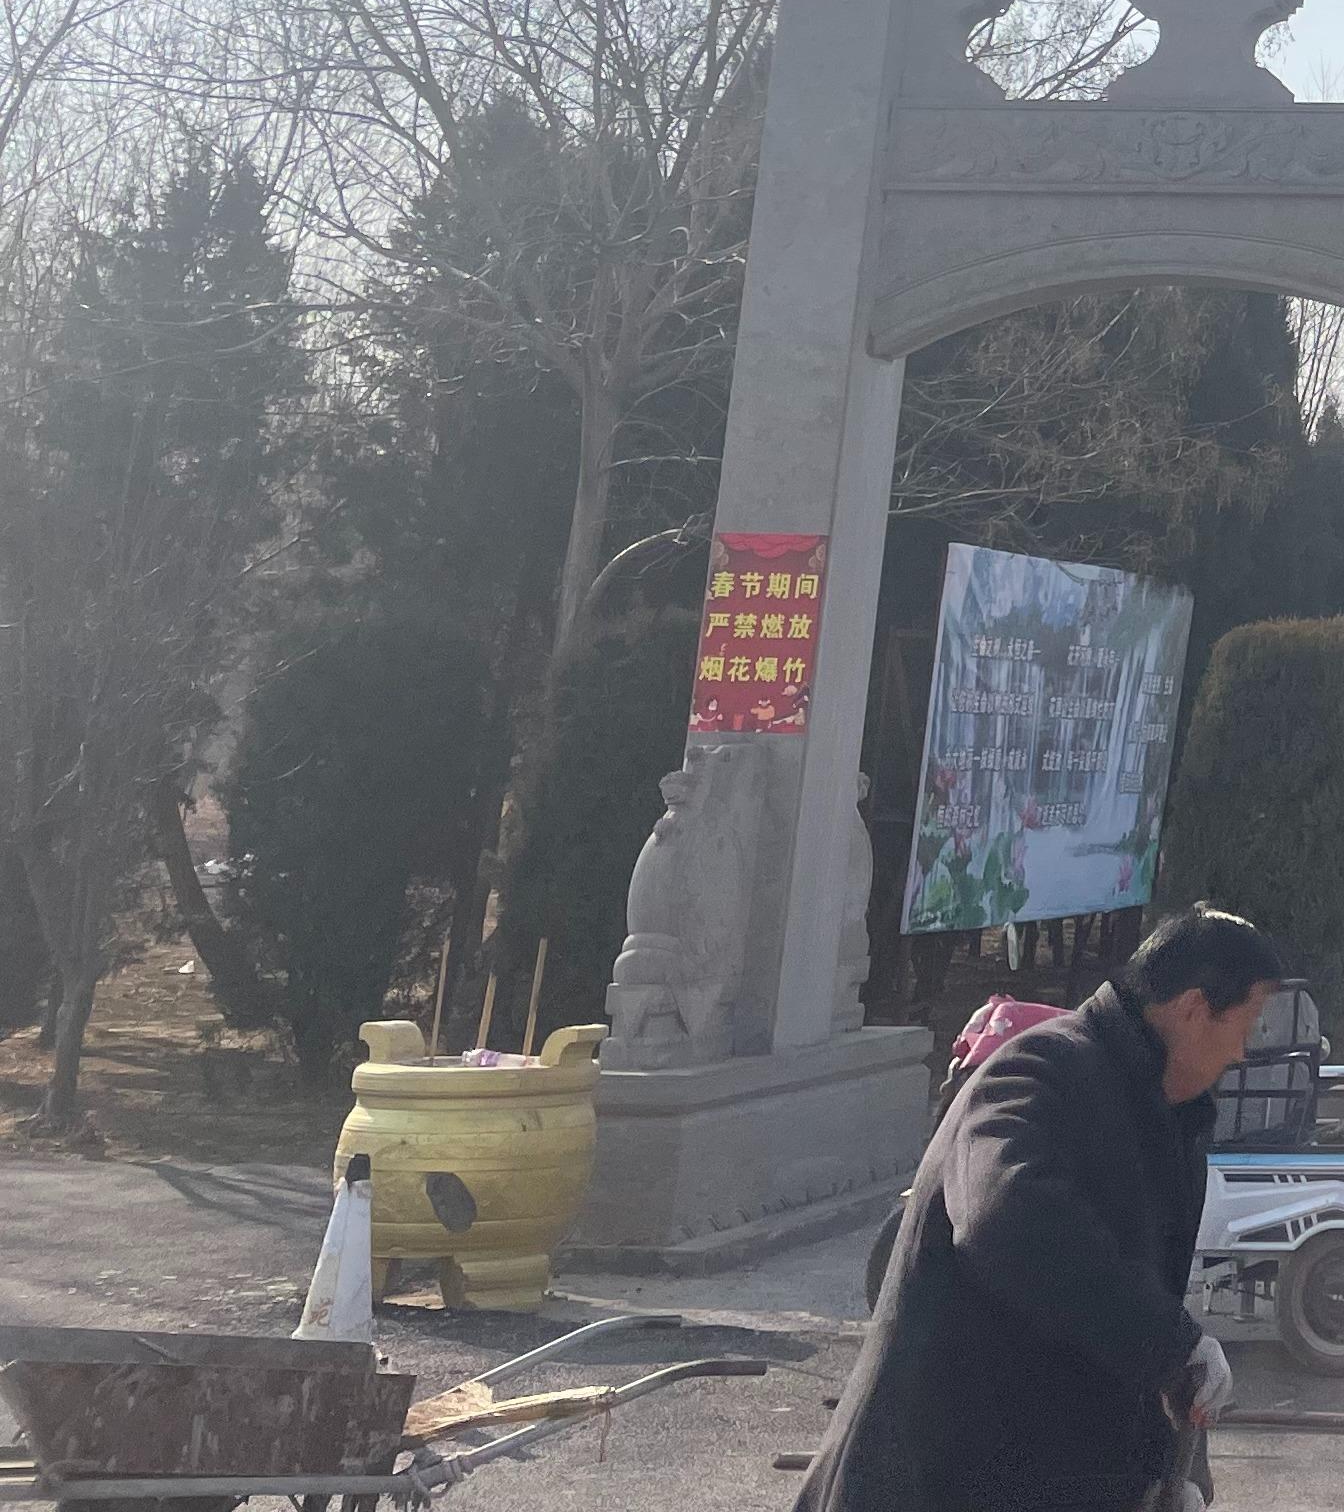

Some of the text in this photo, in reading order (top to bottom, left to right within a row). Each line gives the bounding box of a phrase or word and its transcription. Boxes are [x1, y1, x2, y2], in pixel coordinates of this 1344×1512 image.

[711, 571, 820, 600] 春节期间
[706, 612, 813, 639] 严禁燃放
[699, 656, 806, 683] 烟花爆竹
